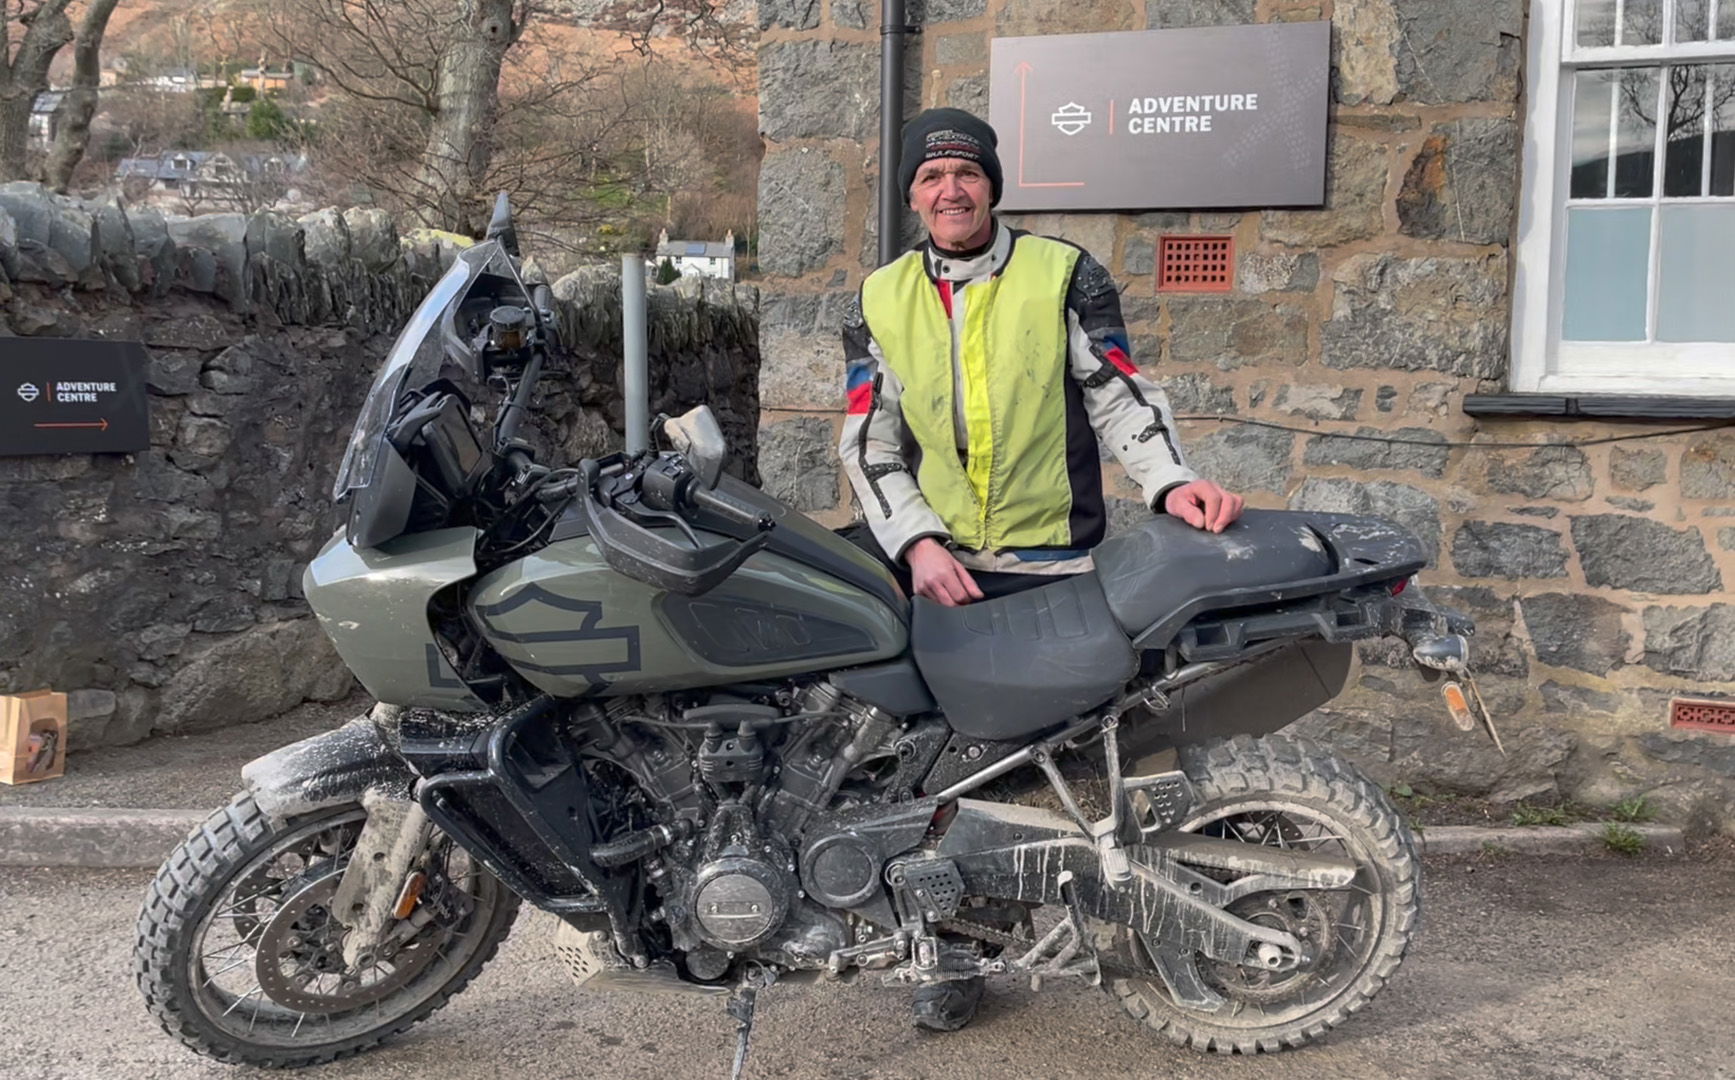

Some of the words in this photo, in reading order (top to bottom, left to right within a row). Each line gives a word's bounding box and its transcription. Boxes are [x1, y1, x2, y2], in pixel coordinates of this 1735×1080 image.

[1128, 93, 1258, 114] ADVENTURE
[1128, 115, 1212, 134] CENTRE
[56, 382, 117, 392] ADVENTURE
[57, 393, 98, 402] CENTRE
